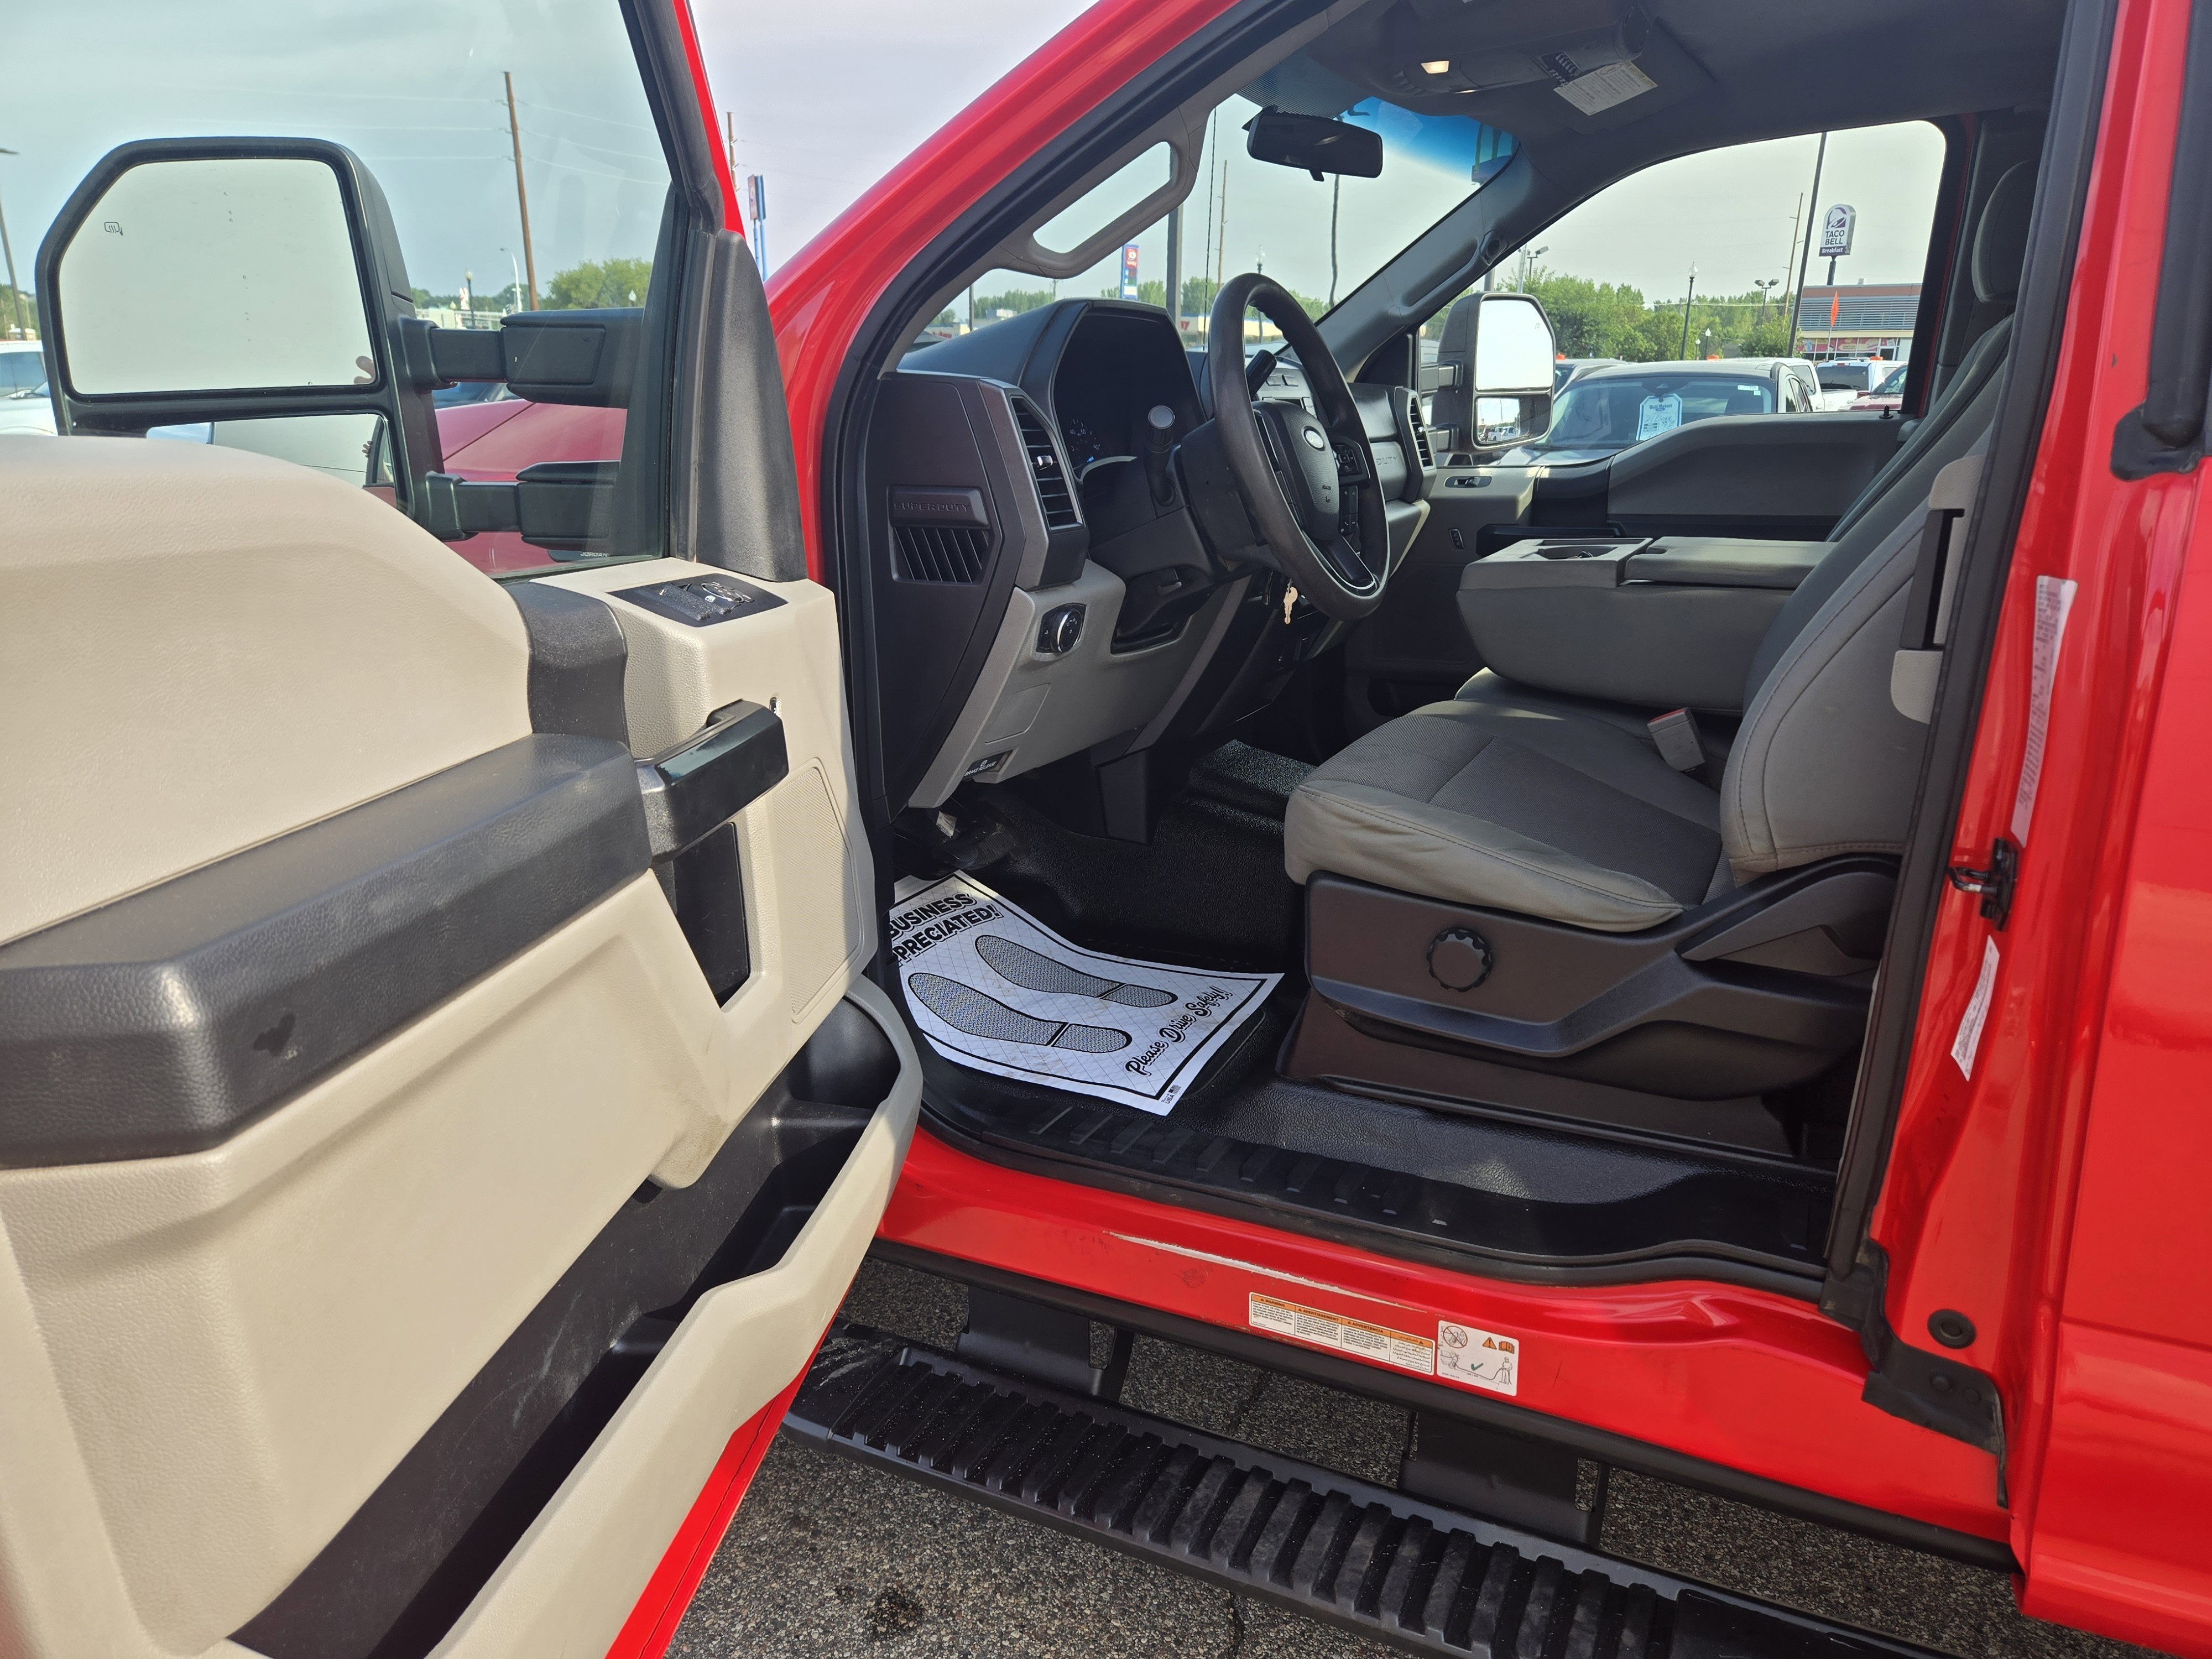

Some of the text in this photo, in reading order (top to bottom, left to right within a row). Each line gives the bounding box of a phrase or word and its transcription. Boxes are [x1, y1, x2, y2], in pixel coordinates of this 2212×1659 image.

[892, 904, 1003, 966] PRECIATED!
[1125, 985, 1233, 1076] Please Drive Safety!
[1165, 1094, 1175, 1104] USA
[1265, 1299, 1285, 1307] WARNING
[1303, 1309, 1339, 1322] AVERTISSEMENT
[1352, 1322, 1384, 1333] ADVERTENCIA
